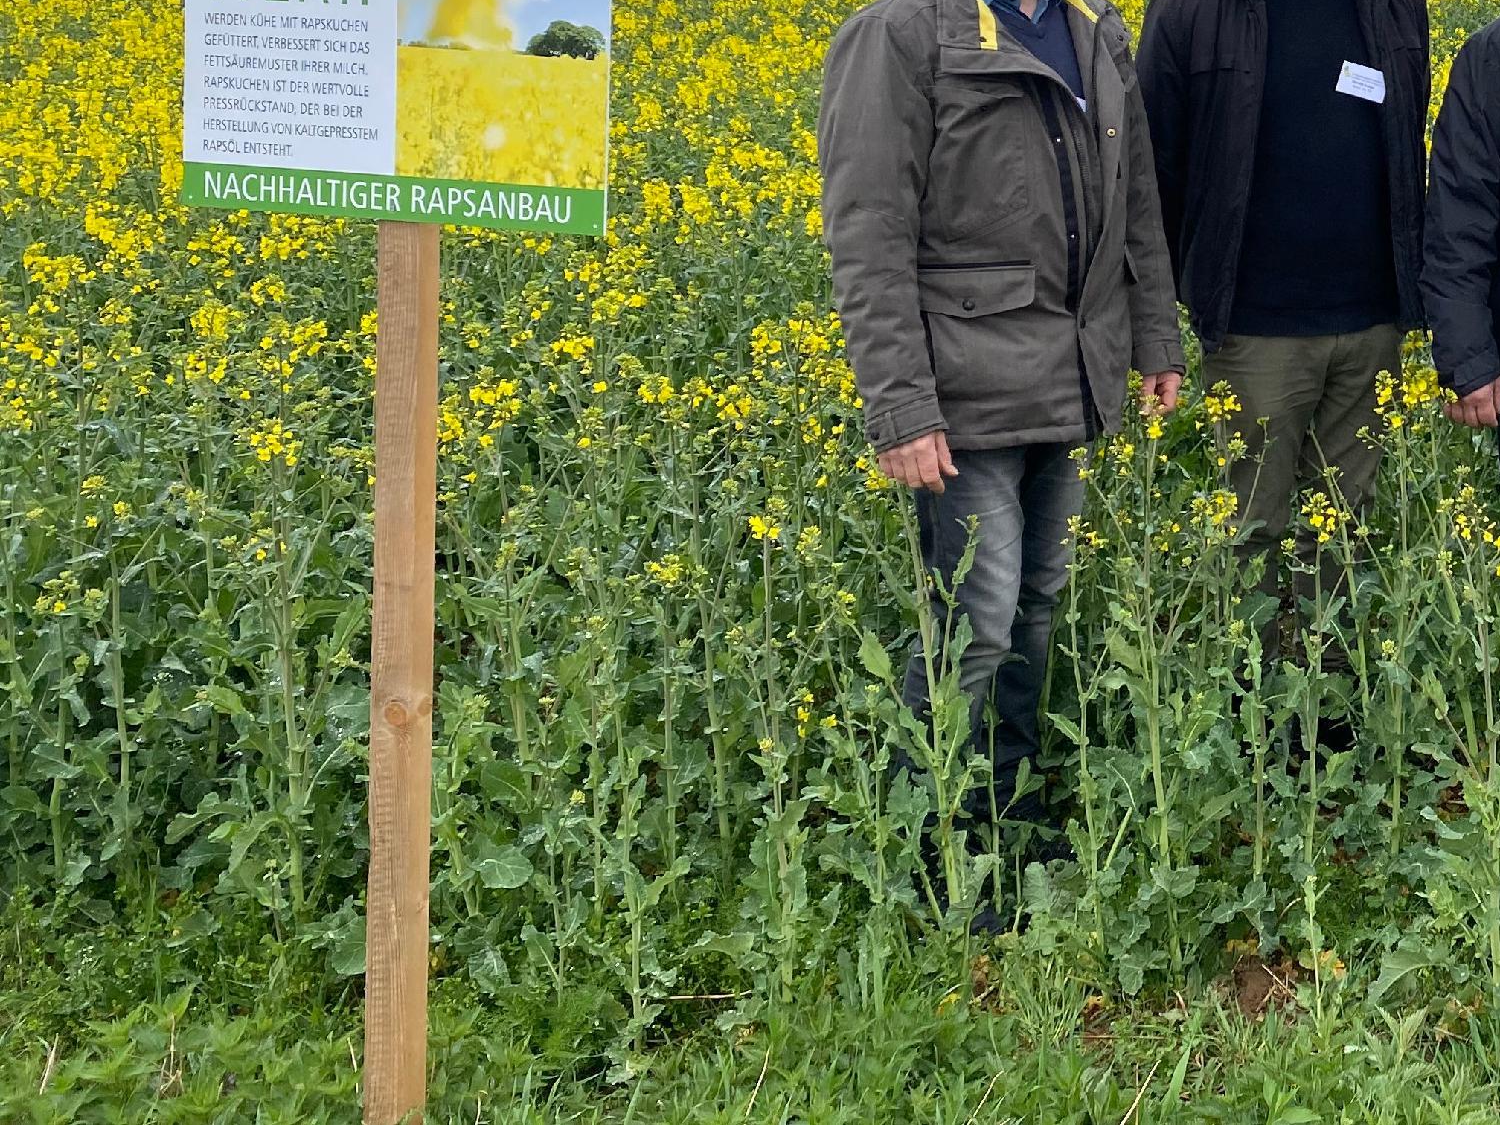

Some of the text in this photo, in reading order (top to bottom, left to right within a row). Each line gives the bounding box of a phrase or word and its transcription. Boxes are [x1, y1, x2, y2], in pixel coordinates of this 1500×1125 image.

[204, 13, 368, 32] WERDEN KÜHE MIT RAPSKUCHEN
[204, 33, 370, 54] GEFÜTTERT, VERBESSERT SICH DAS
[204, 54, 368, 75] FETTSÄUREMUSTER IHRER MILCH.
[204, 76, 369, 97] RAPSKUCHEN IST DER WERTVOLLE
[300, 103, 319, 115] DER
[324, 104, 339, 116] BEI
[343, 106, 362, 118] DER
[204, 118, 378, 141] HERSTELLUNG VON KALTGEPRESSTEM
[203, 139, 240, 153] RAPSÖL
[203, 170, 572, 224] NACHHALTIGER RAPSANBAU
